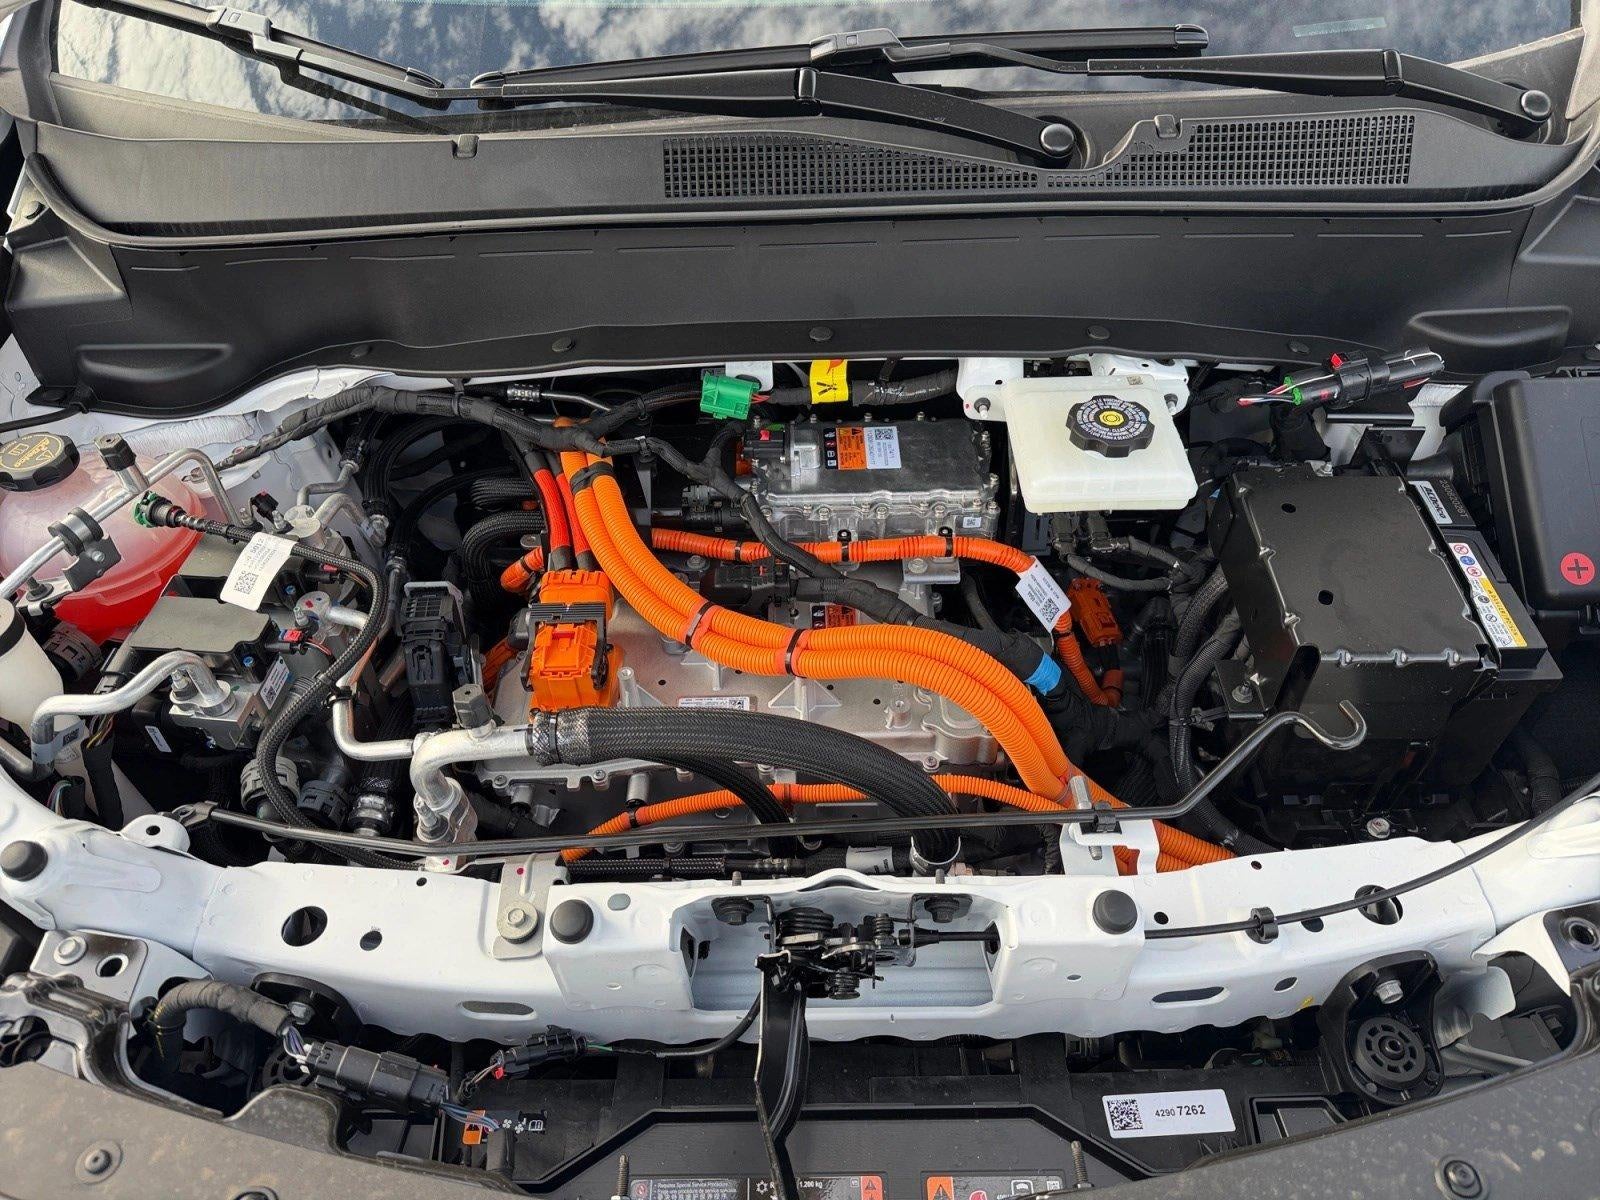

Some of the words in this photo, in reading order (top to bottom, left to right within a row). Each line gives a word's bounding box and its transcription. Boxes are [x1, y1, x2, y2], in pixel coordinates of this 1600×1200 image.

[1422, 485, 1447, 519] ACDelco
[1155, 1108, 1176, 1117] 4290
[1176, 1104, 1206, 1116] 7262
[815, 1180, 823, 1189] kg
